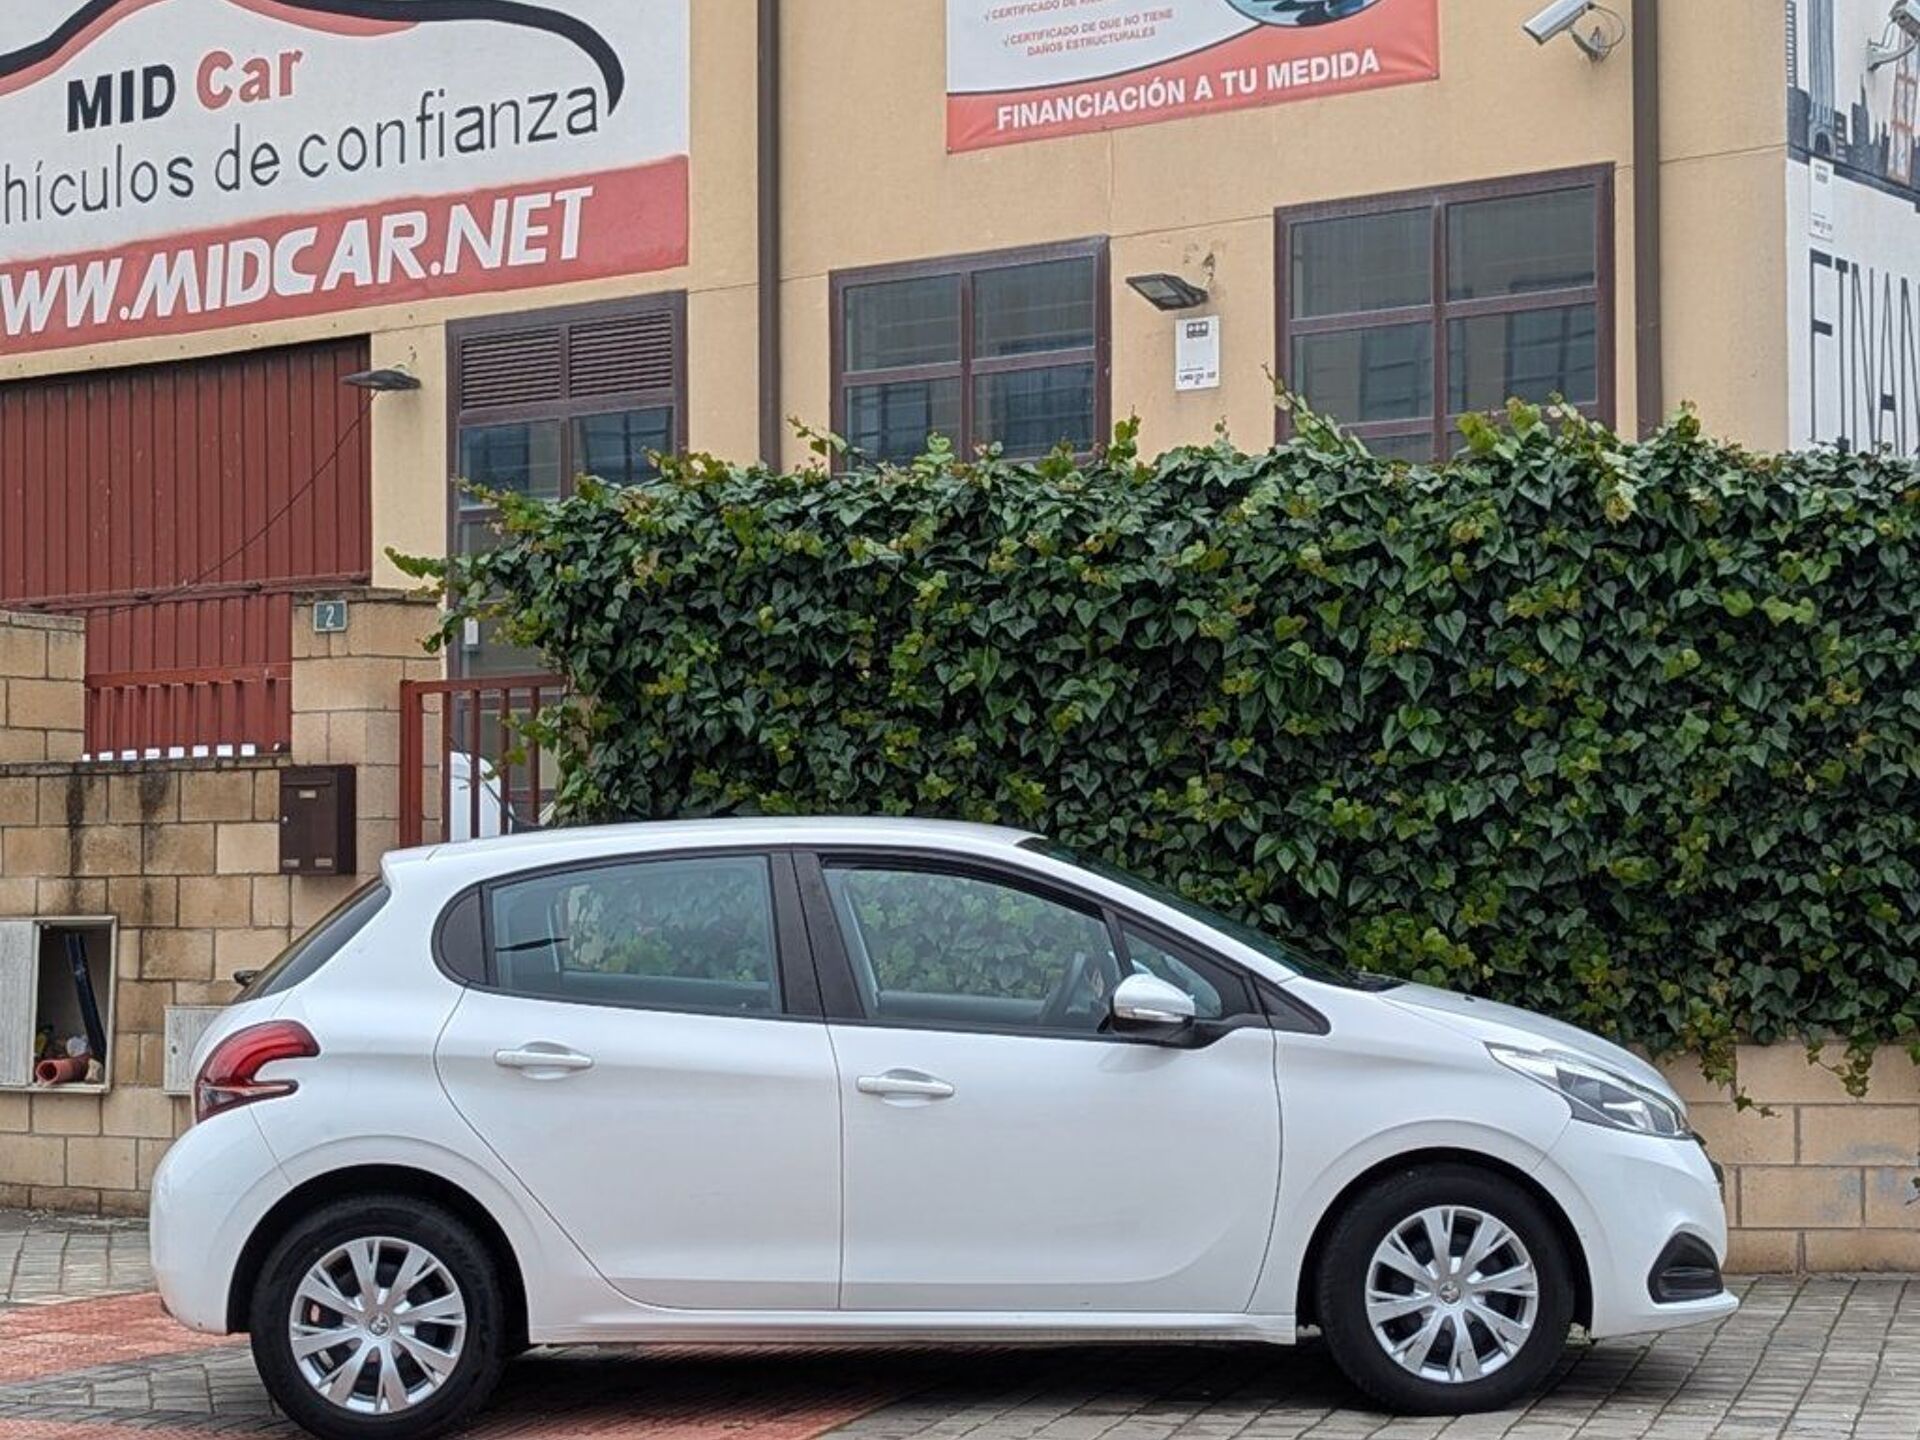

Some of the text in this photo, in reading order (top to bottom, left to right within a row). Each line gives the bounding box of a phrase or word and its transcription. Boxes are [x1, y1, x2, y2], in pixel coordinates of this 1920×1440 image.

[992, 0, 1060, 20] CERTIFICADO
[1010, 8, 1173, 44] CERTIFICADO DE QUE NO TIENE
[1066, 26, 1157, 51] ESTRUCTURALES
[67, 47, 303, 133] MID Car
[997, 48, 1380, 131] FINANCIACIÓN A TU MEDIDA
[215, 123, 280, 192] de
[299, 85, 598, 178] confianza
[326, 605, 335, 627] 2
